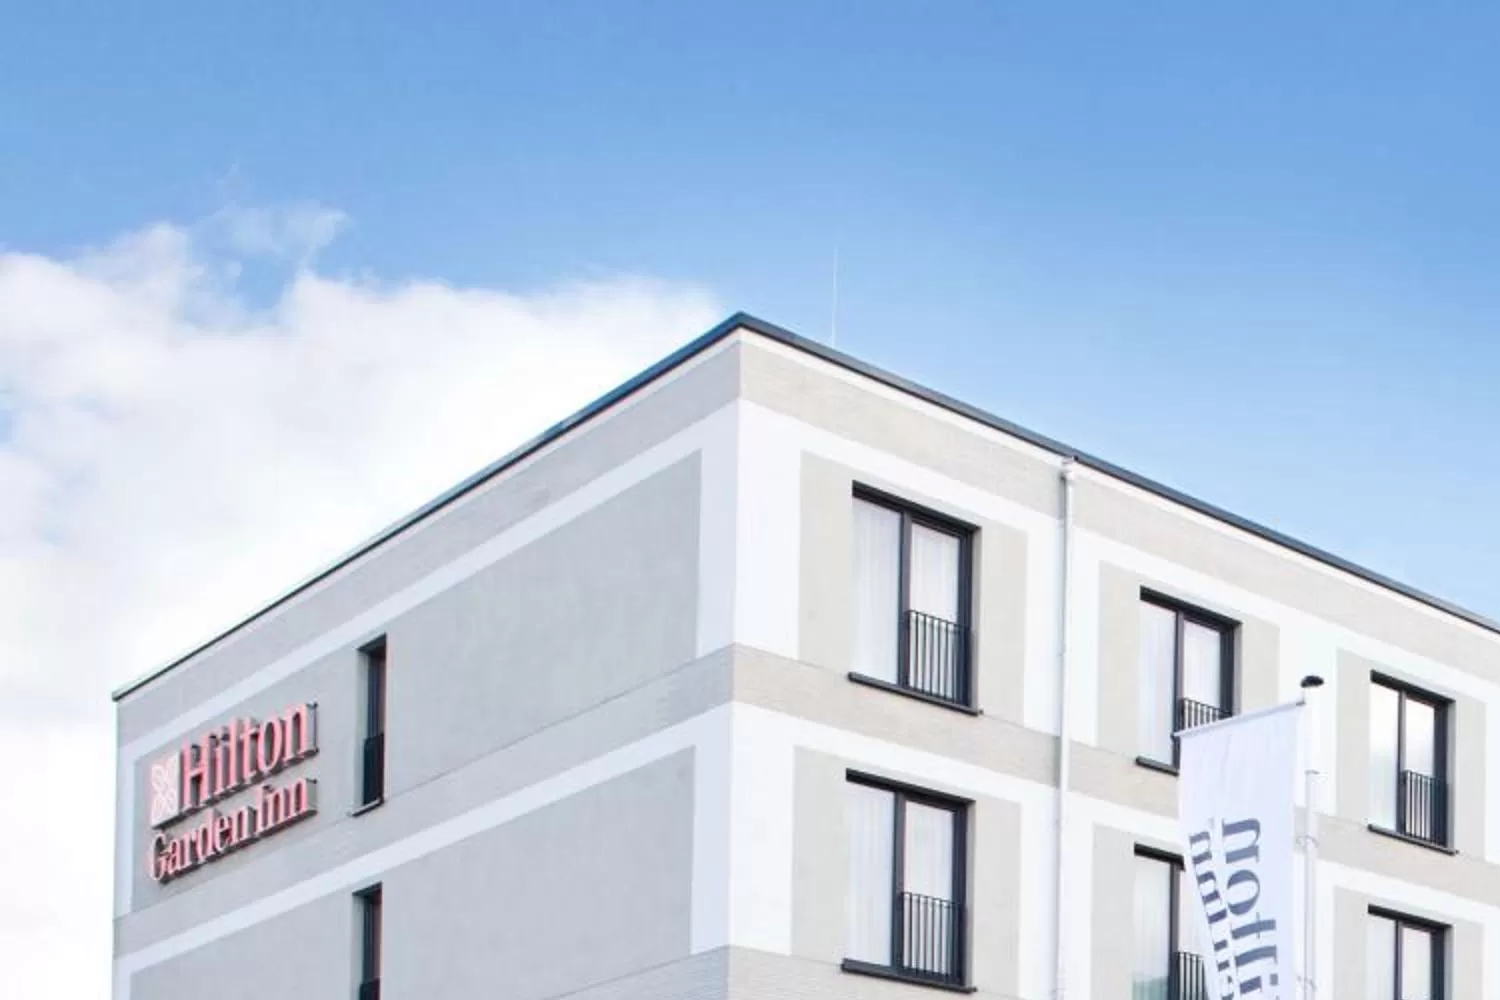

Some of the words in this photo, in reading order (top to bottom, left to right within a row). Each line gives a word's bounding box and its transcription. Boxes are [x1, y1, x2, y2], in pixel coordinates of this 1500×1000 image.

[180, 702, 309, 812] Hilton
[148, 804, 250, 882] Garden
[254, 777, 309, 835] Inn
